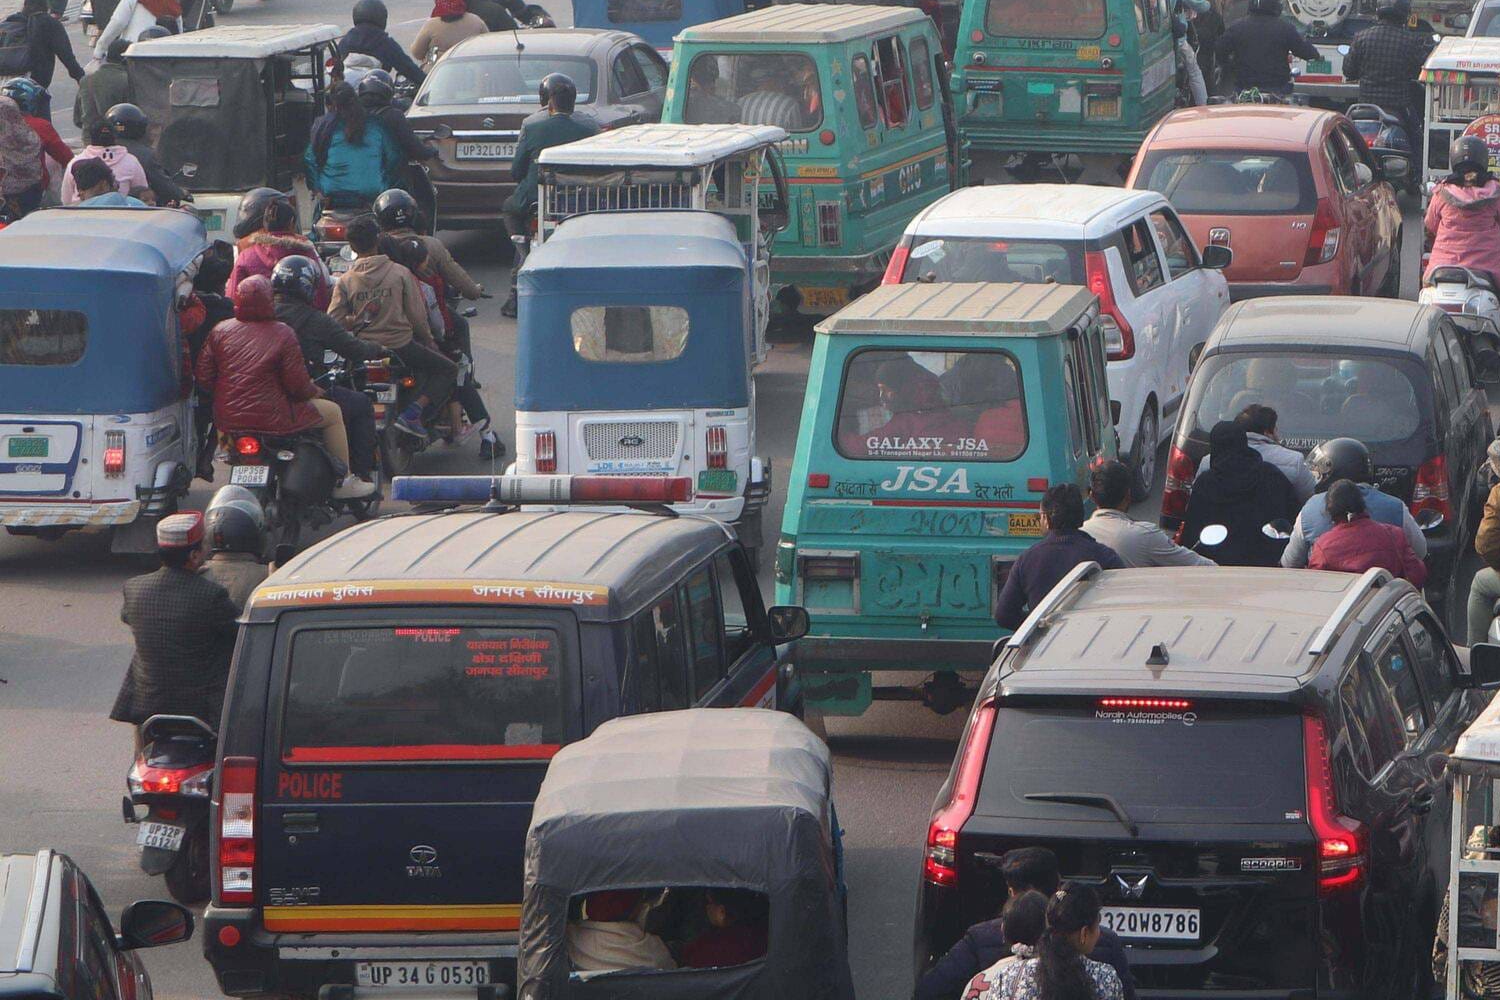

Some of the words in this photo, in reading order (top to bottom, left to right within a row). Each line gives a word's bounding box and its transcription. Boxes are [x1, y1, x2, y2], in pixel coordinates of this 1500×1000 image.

[357, 286, 393, 301] GUCCI
[866, 437, 943, 450] GALAXY
[956, 438, 989, 451] JSA
[881, 466, 971, 494] JSA
[266, 586, 325, 602] यातायात
[333, 583, 375, 601] पुलिस
[471, 584, 525, 599] जनपद
[533, 584, 595, 604] सीतापुर
[1095, 710, 1125, 719] Narain
[1126, 711, 1183, 720] Automobiles
[276, 771, 343, 798] POLICE
[405, 865, 442, 879] TATA
[371, 966, 392, 985] UP
[398, 966, 419, 984] 34
[425, 966, 435, 984] G
[440, 966, 486, 985] 0530
